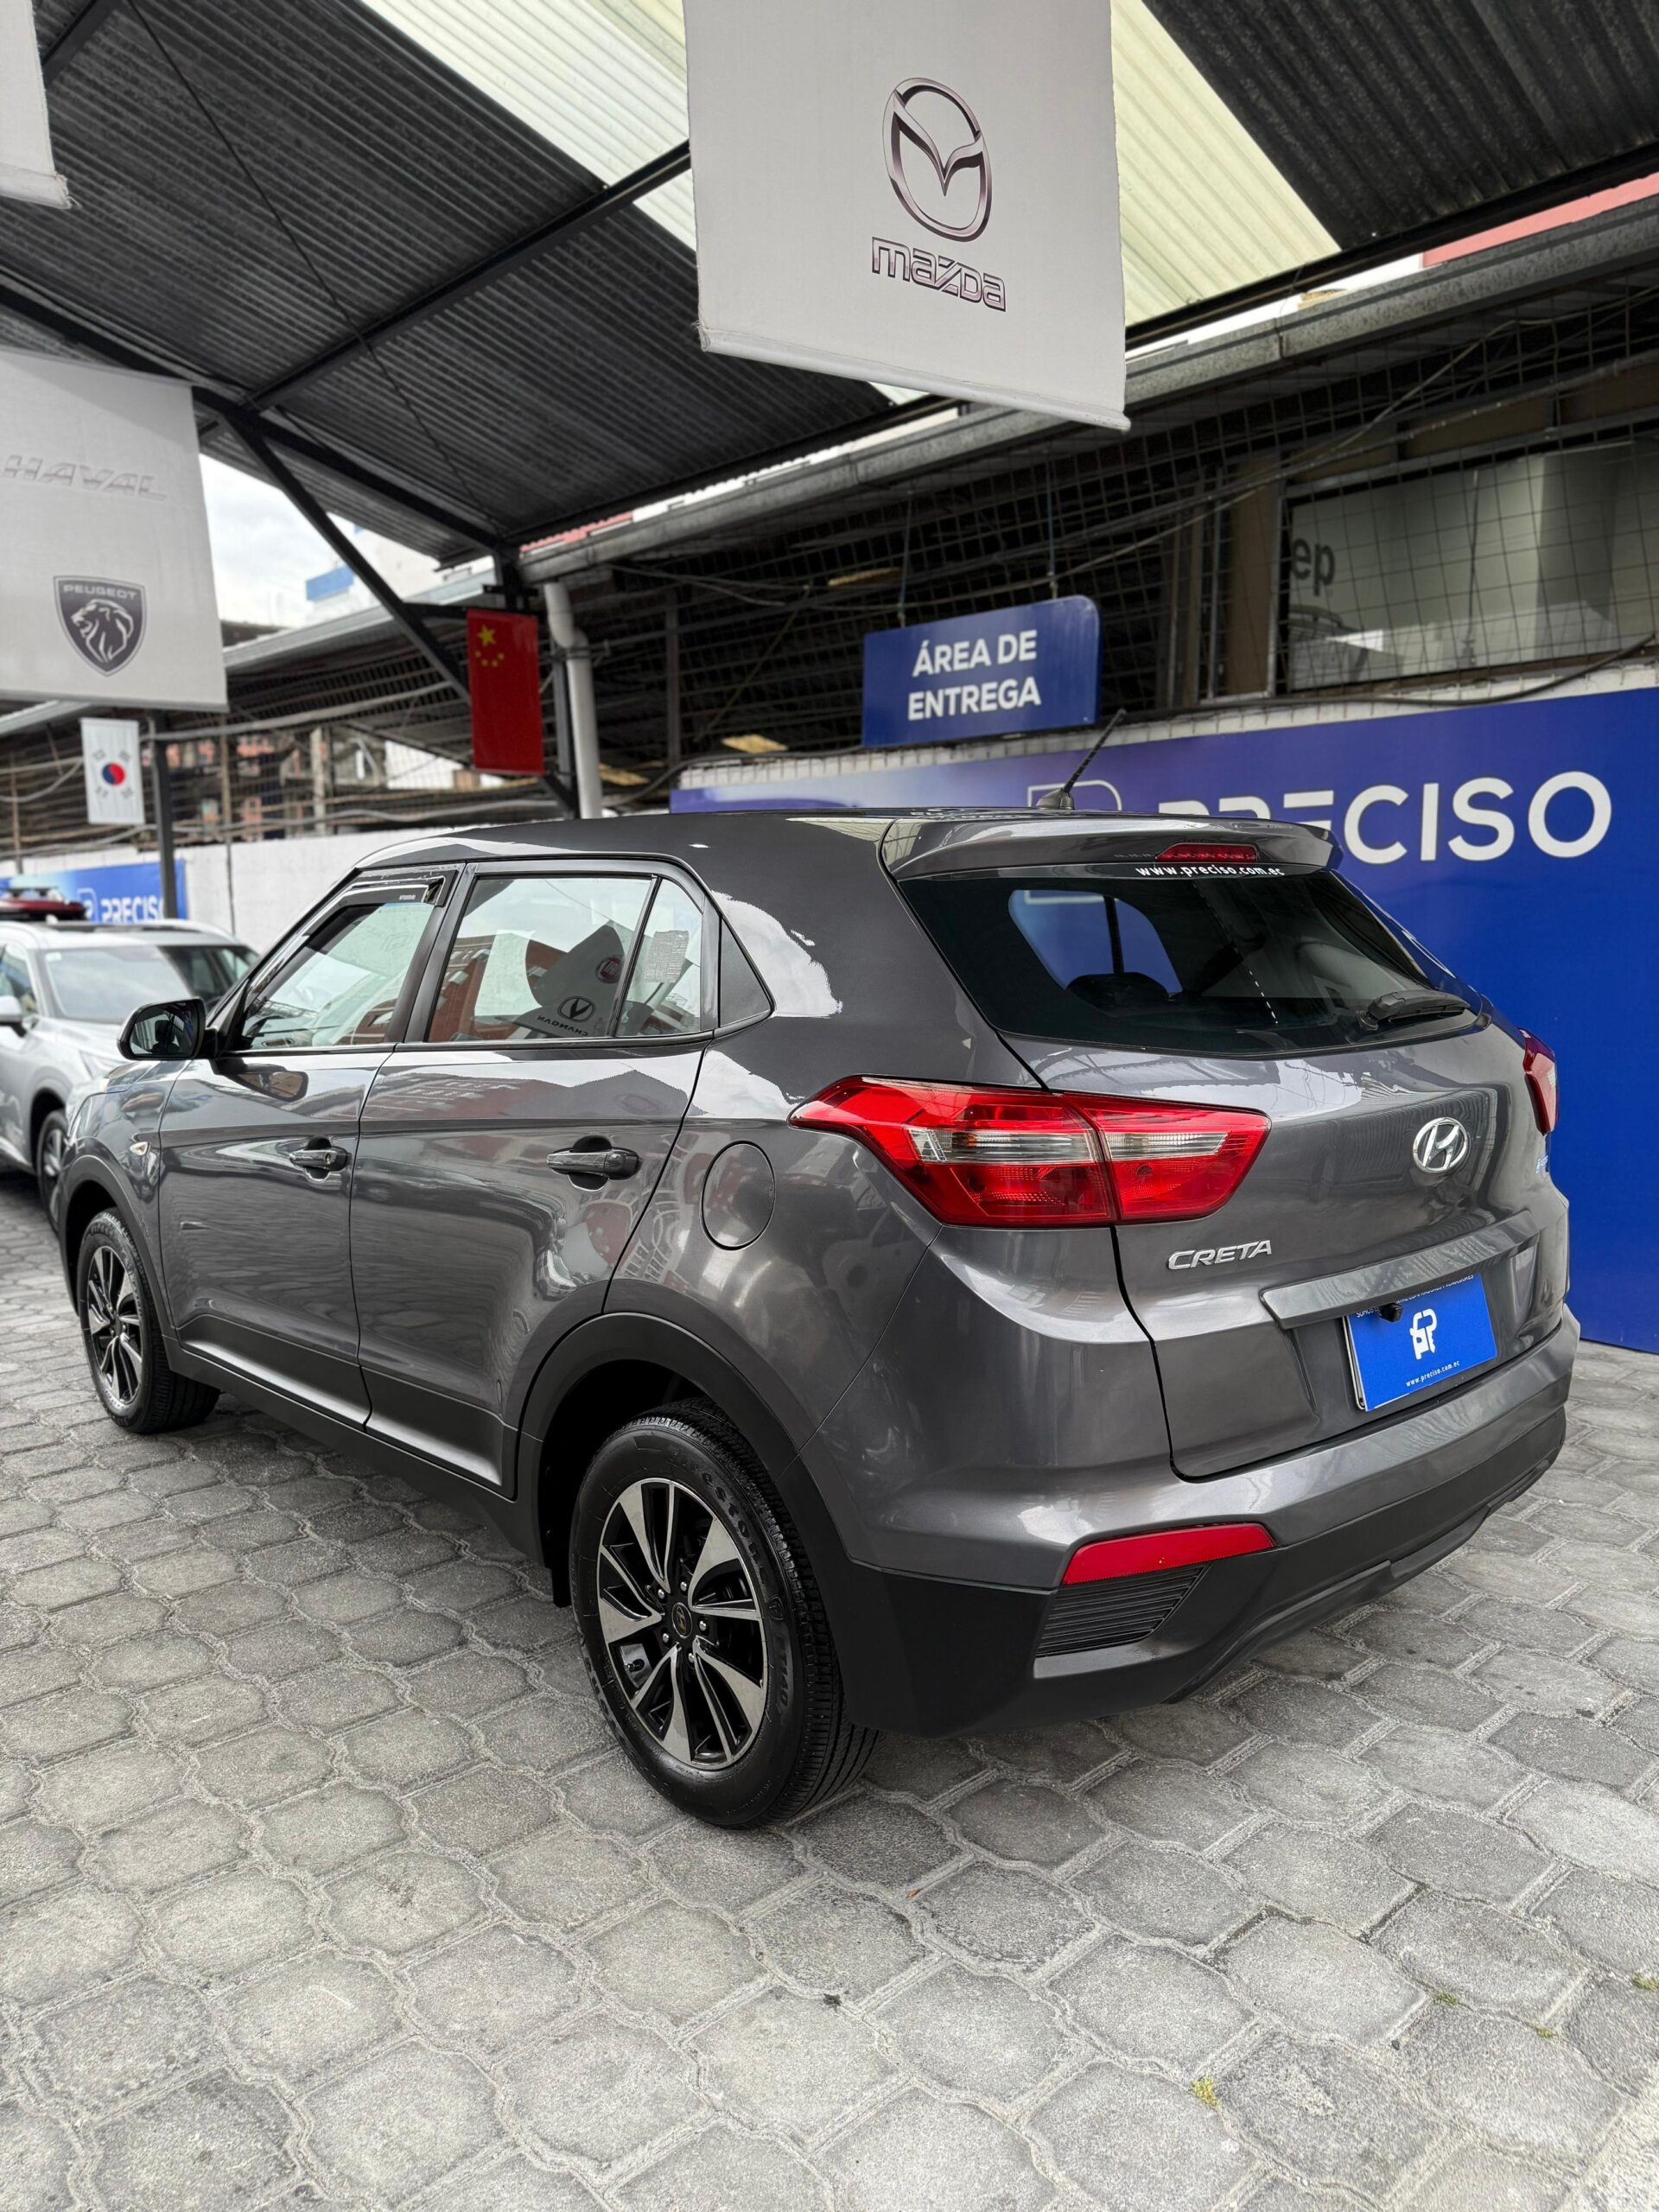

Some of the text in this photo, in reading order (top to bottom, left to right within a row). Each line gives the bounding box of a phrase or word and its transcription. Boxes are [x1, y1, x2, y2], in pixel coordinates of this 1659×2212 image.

[3, 454, 168, 501] HAVAL
[63, 584, 137, 600] PEUGEOT
[912, 629, 1038, 677] ÁREA DE
[908, 677, 1042, 721] ENTREGA
[1158, 771, 1612, 865] CISO
[1135, 864, 1286, 877] www.preciso.com.ec
[1167, 1240, 1273, 1270] CRETA
[1406, 1360, 1461, 1388] www.preciso.com.ec
